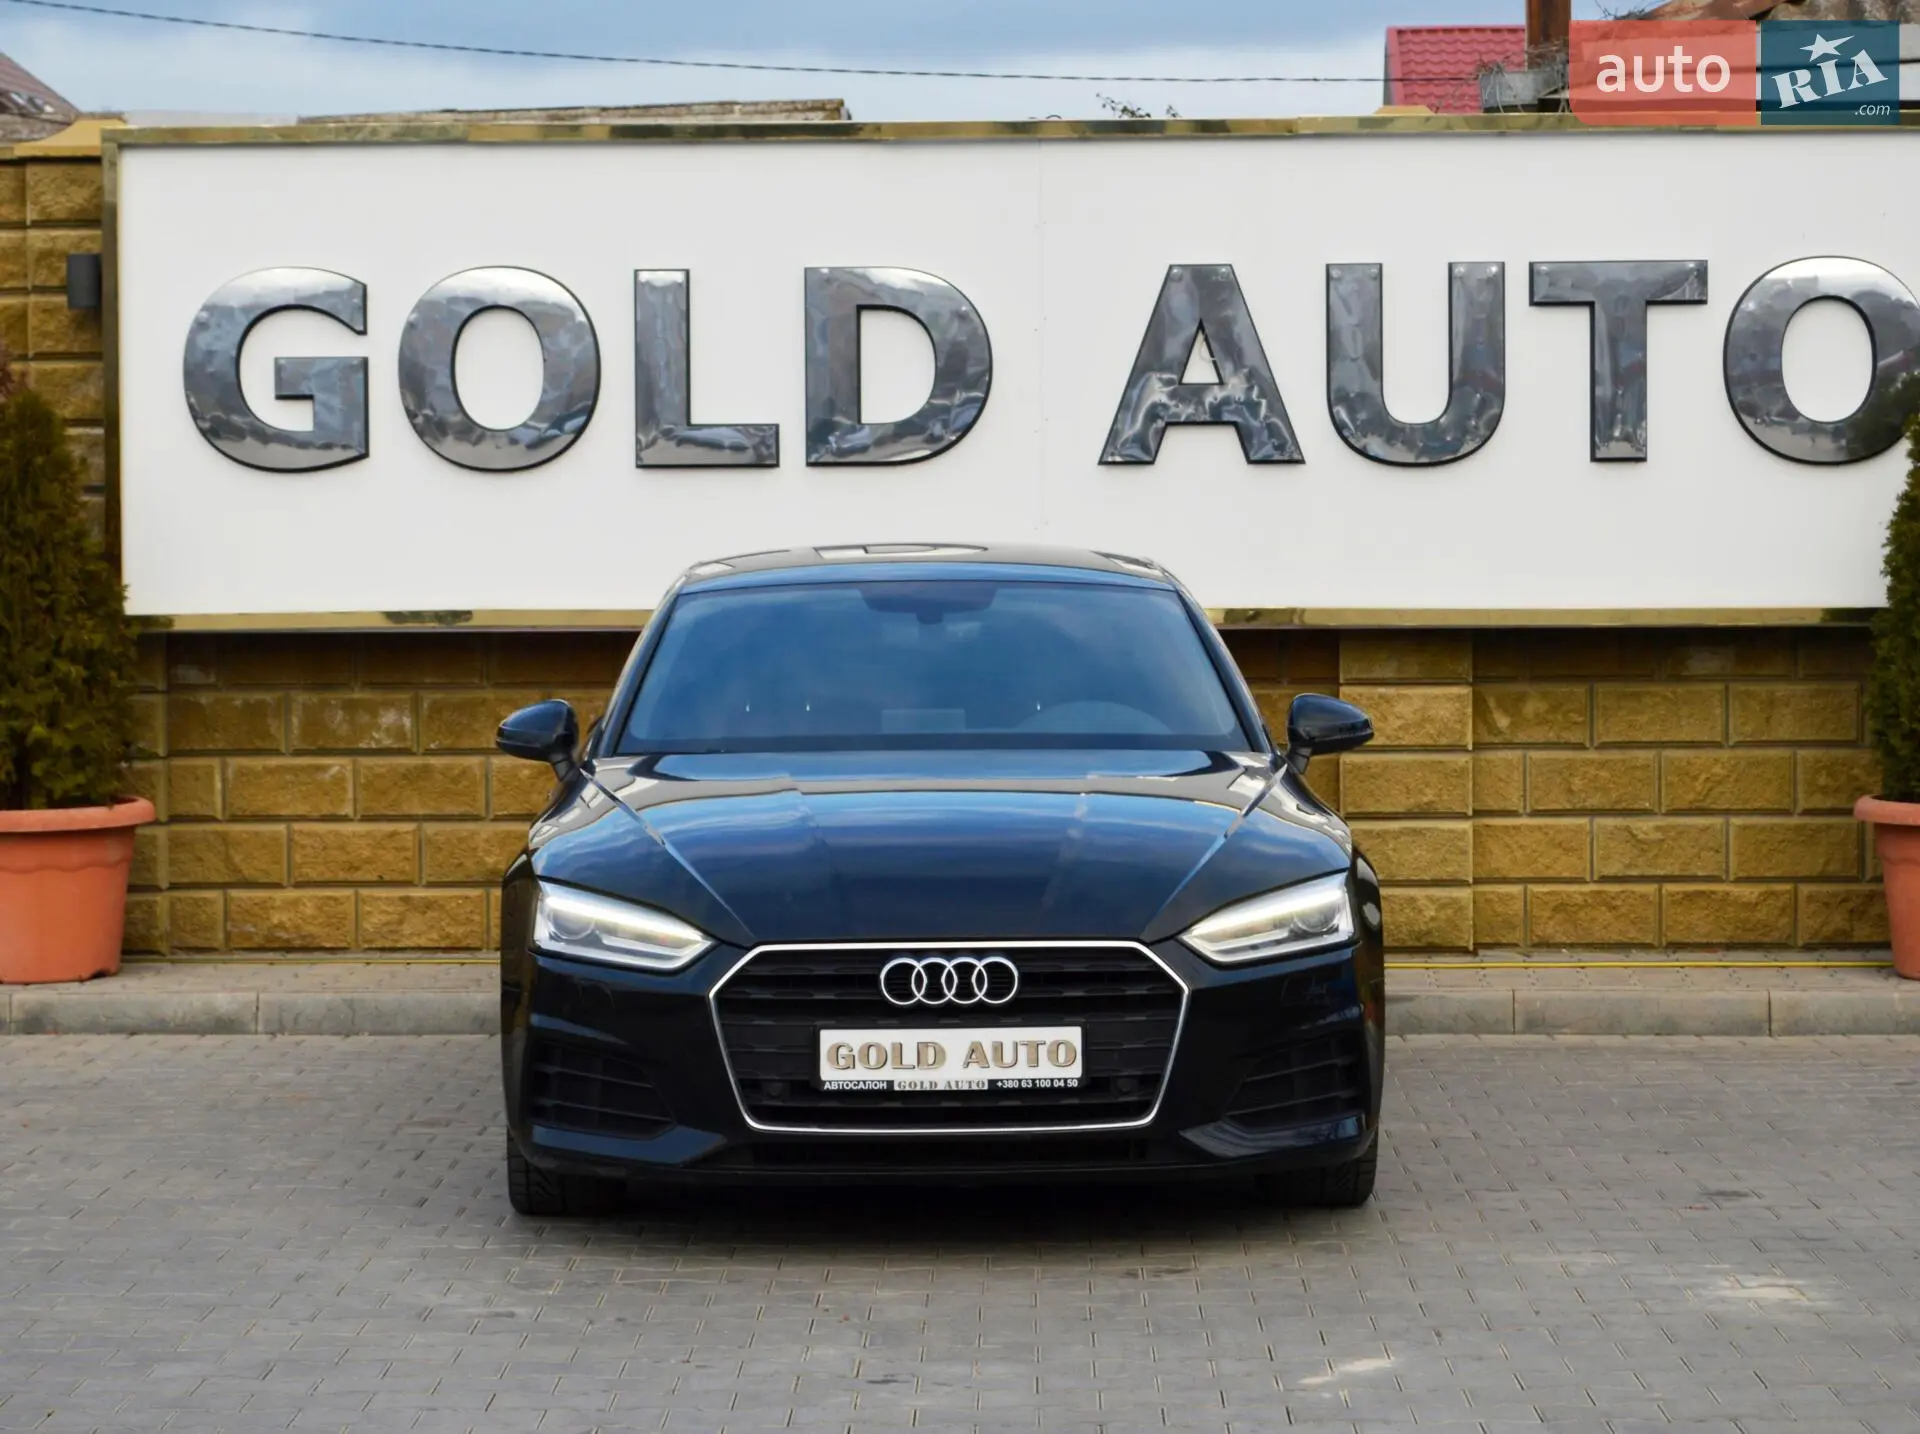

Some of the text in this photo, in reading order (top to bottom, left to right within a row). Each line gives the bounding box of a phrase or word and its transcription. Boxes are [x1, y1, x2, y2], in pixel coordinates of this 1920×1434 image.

[183, 255, 1920, 474] GOLD AUTO
[826, 1039, 1078, 1071] GOLD AUTO
[823, 1080, 887, 1090] АВТОСАЛОН
[897, 1079, 987, 1090] GOLD AUTO
[996, 1079, 1078, 1089] +380 63 100 04 50
